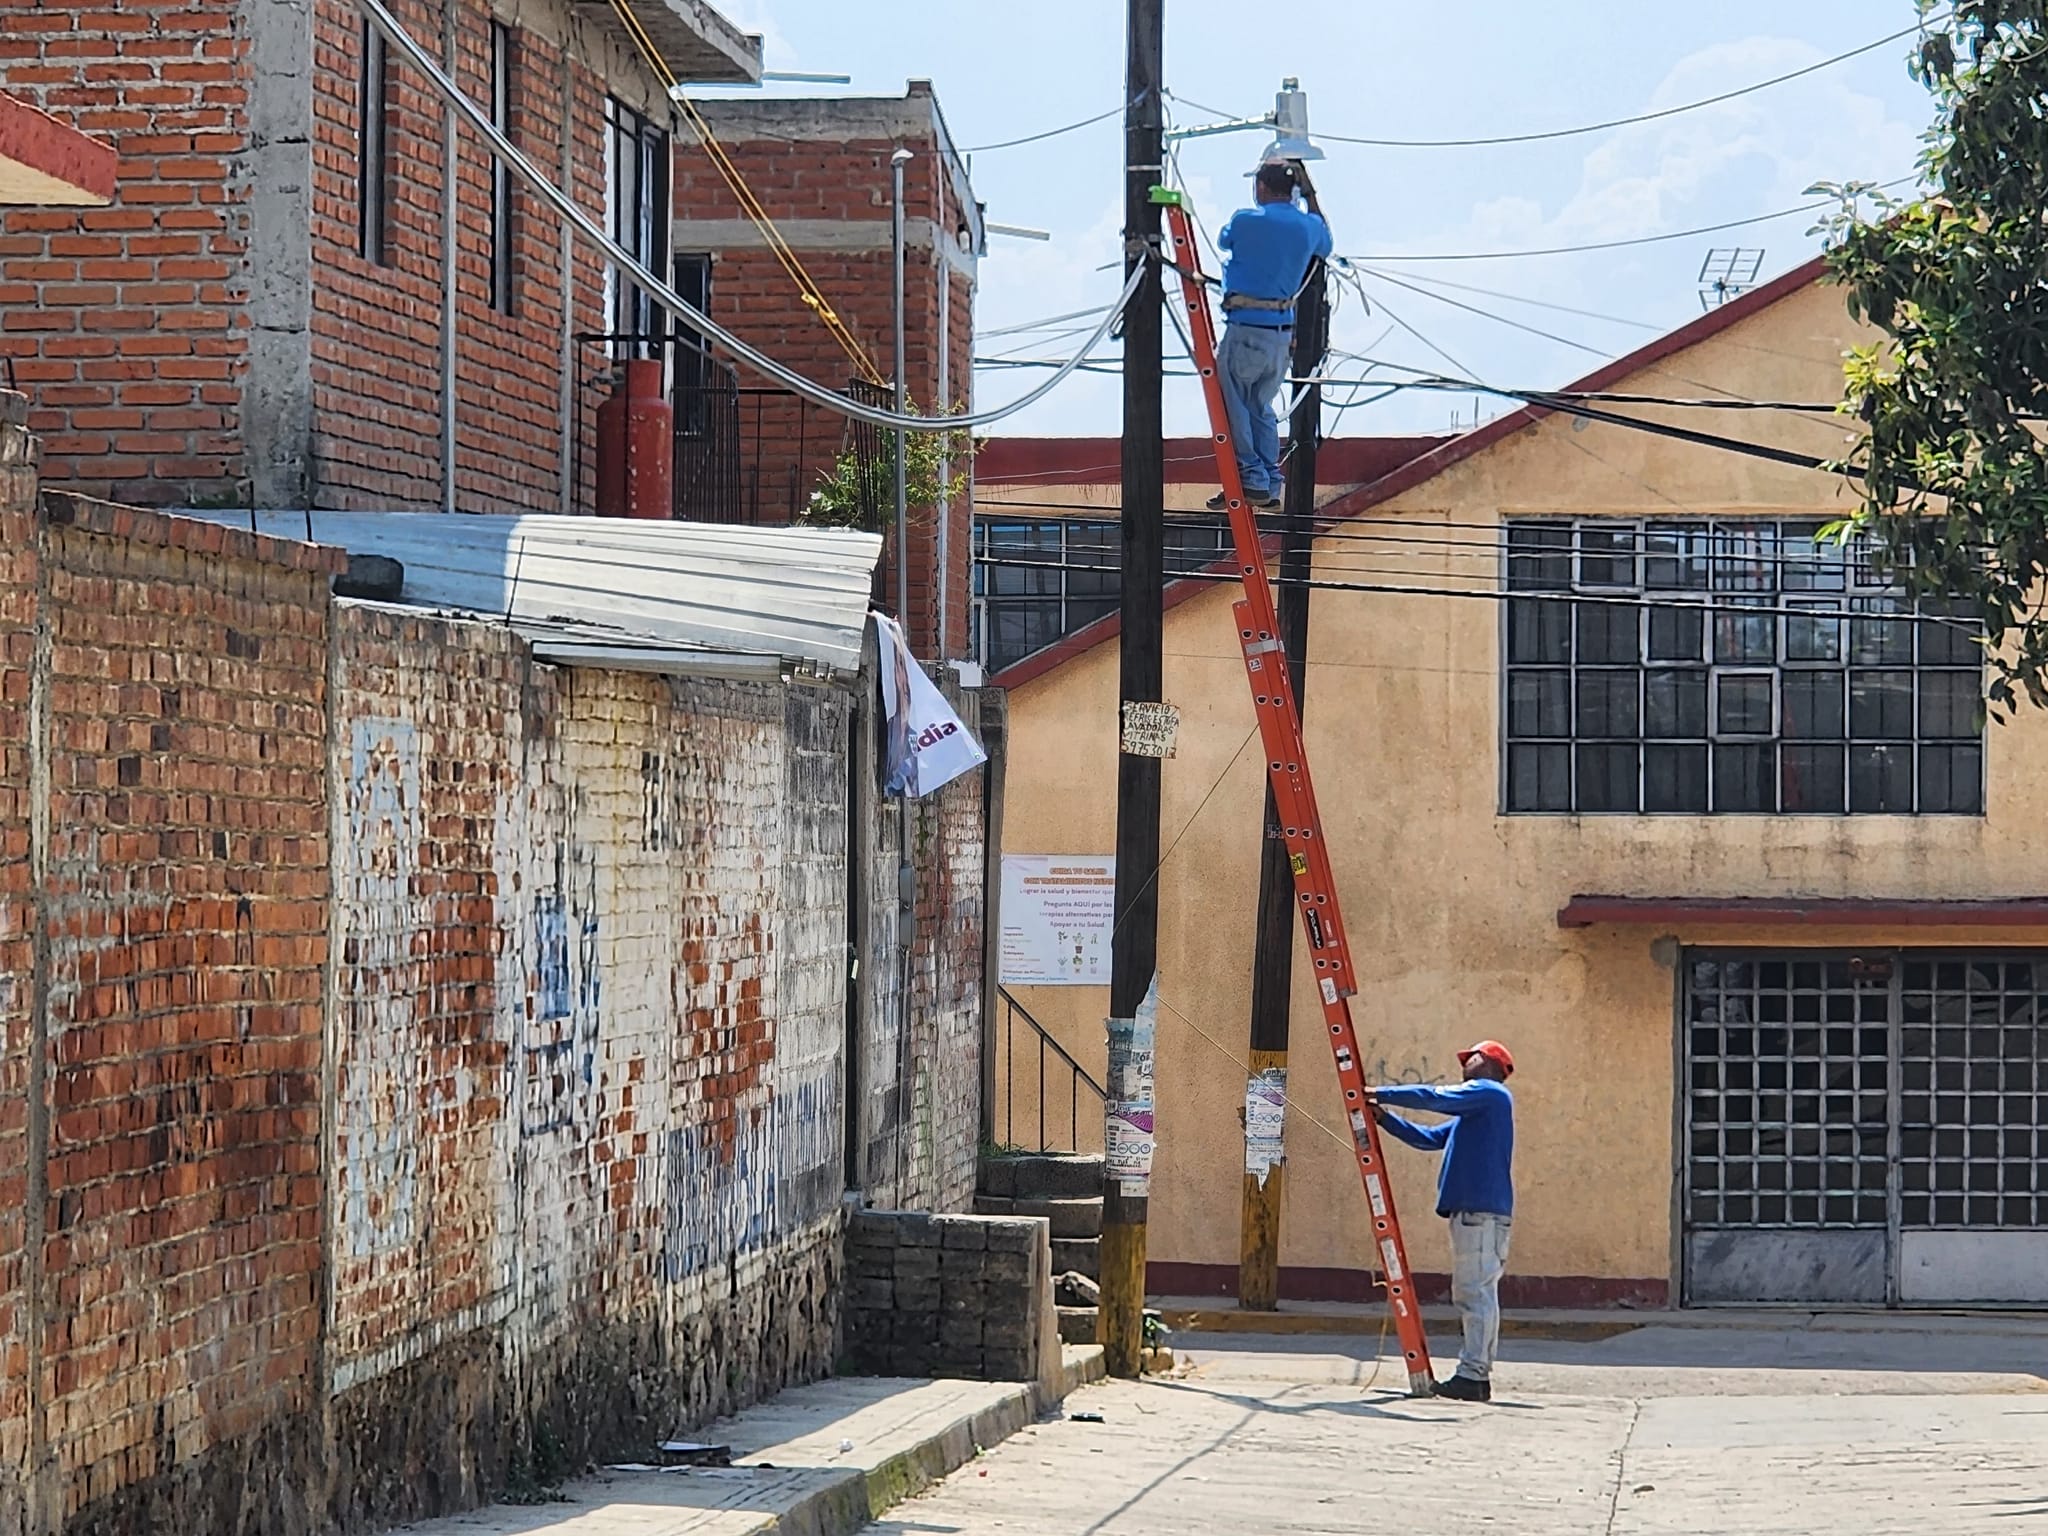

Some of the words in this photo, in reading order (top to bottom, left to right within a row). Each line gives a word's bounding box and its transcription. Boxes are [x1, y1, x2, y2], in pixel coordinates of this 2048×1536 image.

[917, 722, 958, 752] dia
[1043, 900, 1072, 909] Pregunta
[1050, 920, 1072, 929] Apoyar
[1087, 920, 1105, 928] Salud
